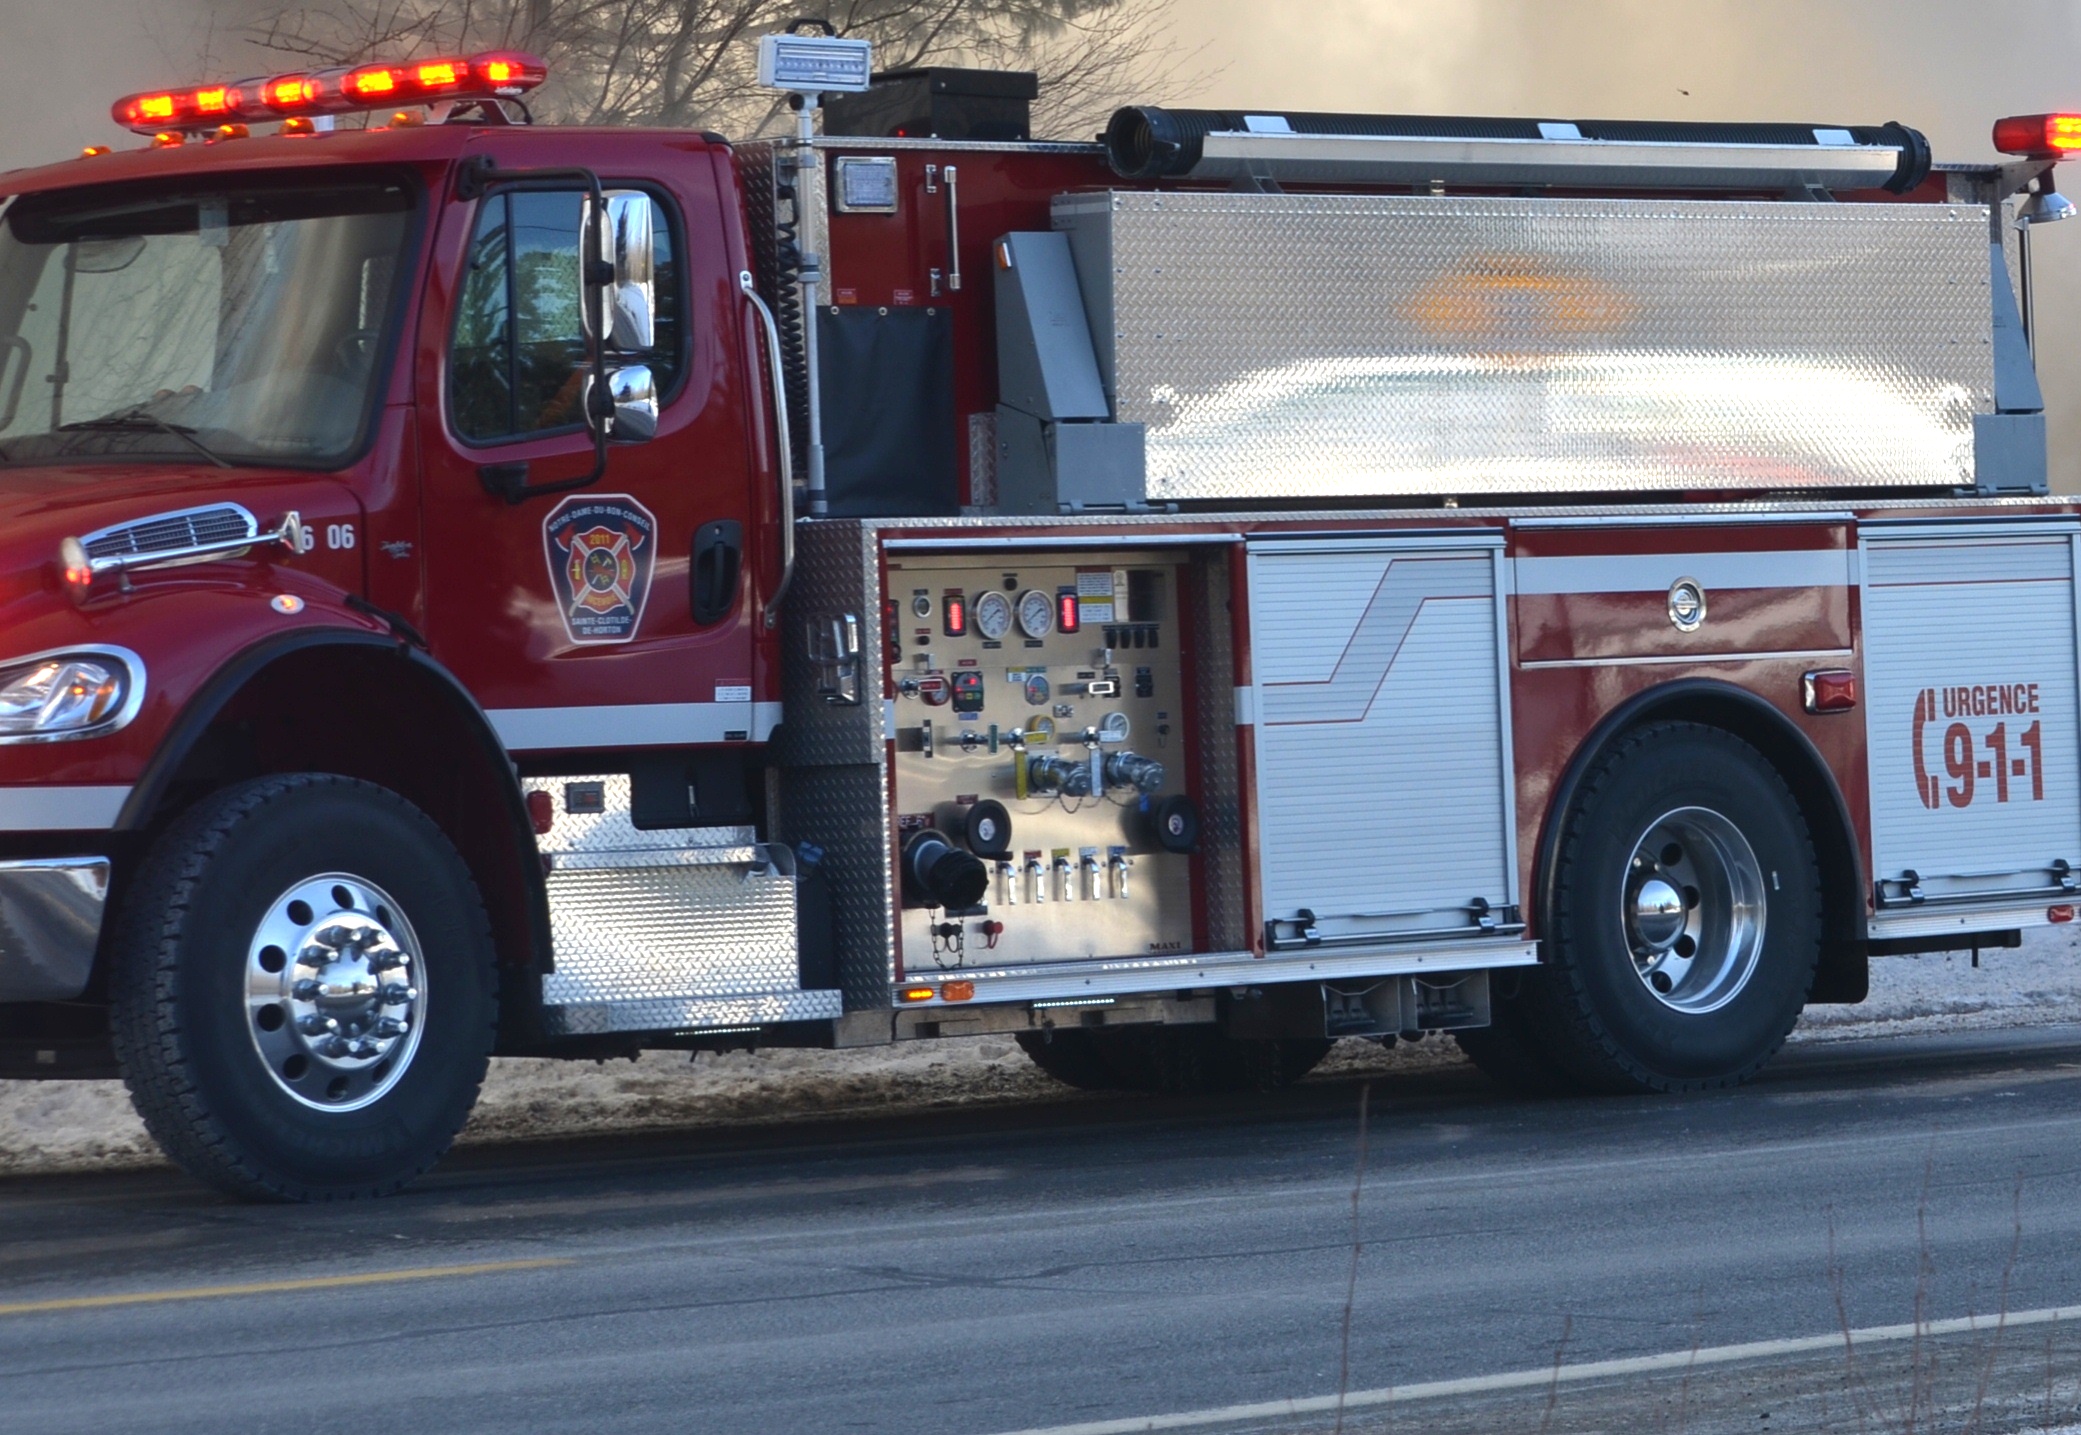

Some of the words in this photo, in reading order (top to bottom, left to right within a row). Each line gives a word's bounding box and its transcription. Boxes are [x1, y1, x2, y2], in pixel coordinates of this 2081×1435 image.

[548, 505, 651, 532] NOTRE-DAME-DU-BON-CONSEIL
[327, 524, 355, 549] 06
[589, 533, 610, 545] 2011
[582, 626, 621, 635] DE-HORTON
[1942, 683, 2040, 718] URGENCE
[1944, 719, 2044, 808] 9-1-1
[1149, 941, 1181, 950] MAXI
